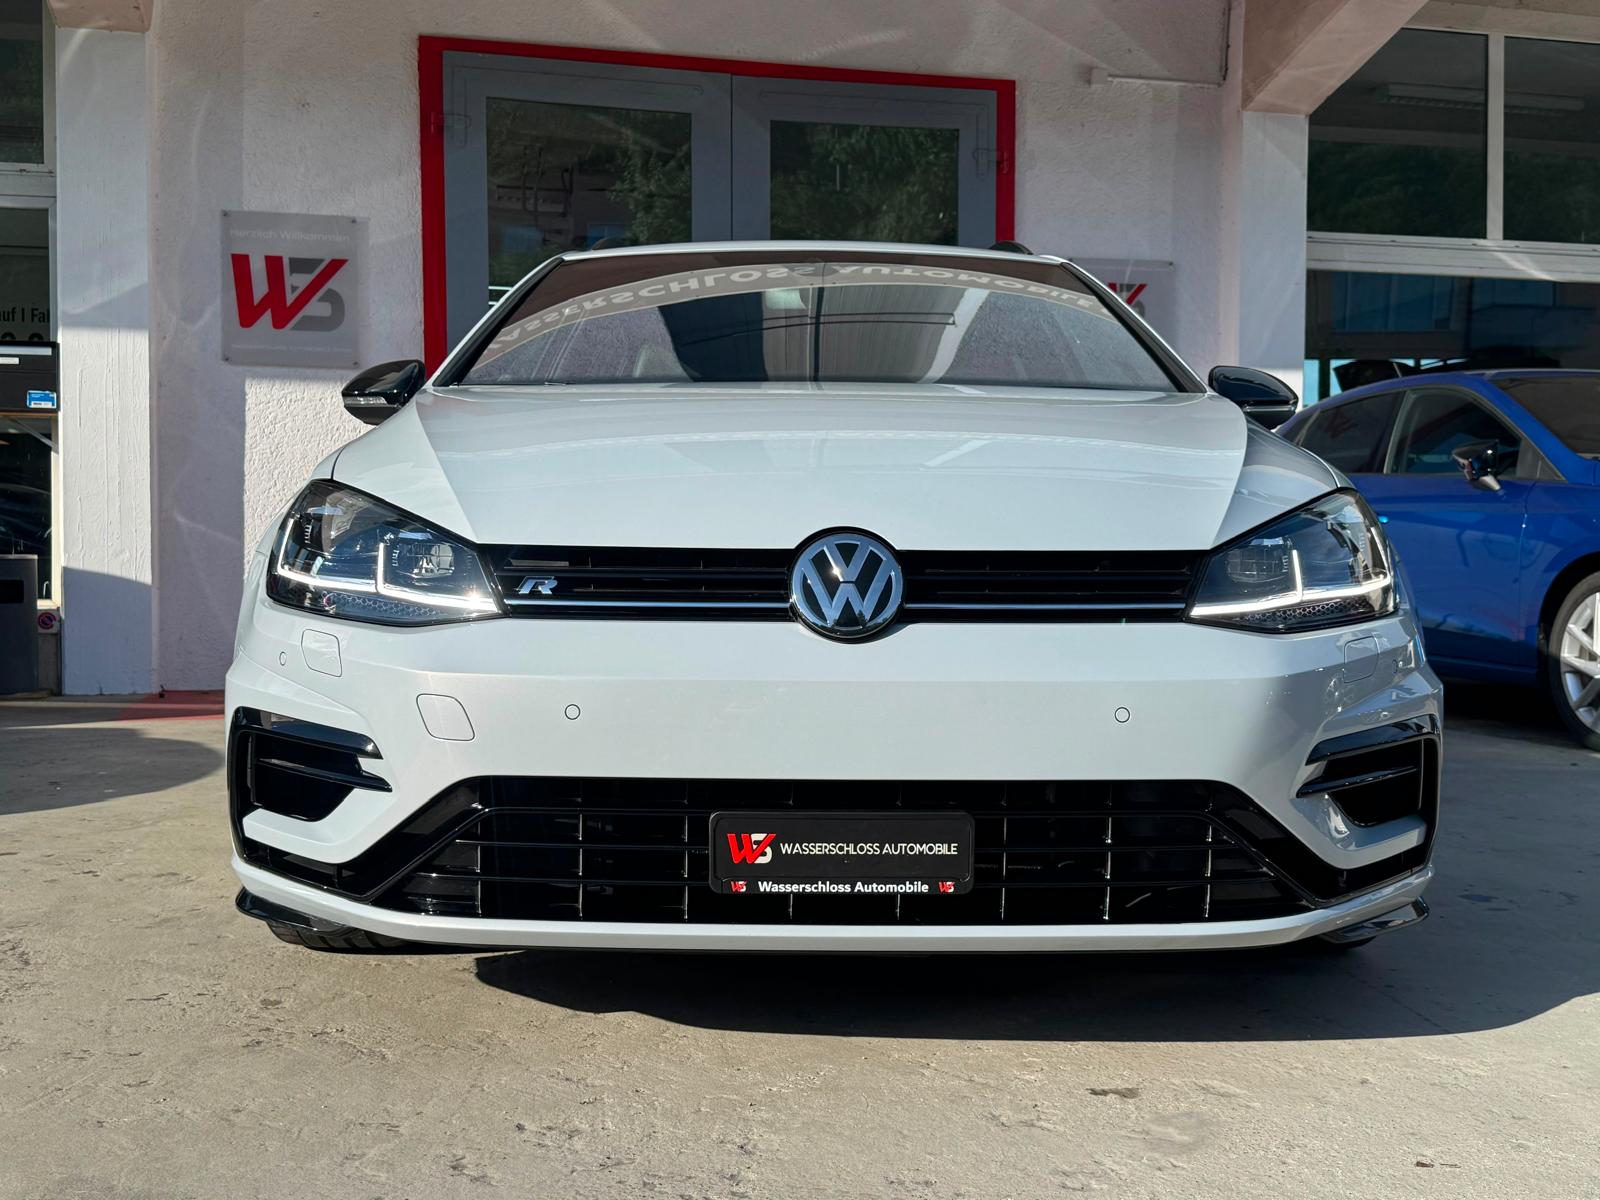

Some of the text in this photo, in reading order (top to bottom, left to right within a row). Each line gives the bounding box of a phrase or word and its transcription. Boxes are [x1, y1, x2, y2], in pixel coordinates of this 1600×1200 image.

[780, 842, 880, 855] WASSERSCHLOSS
[882, 842, 958, 855] AUTOMOBILE
[758, 881, 851, 893] Wasserschloss
[854, 881, 929, 893] Automobile
